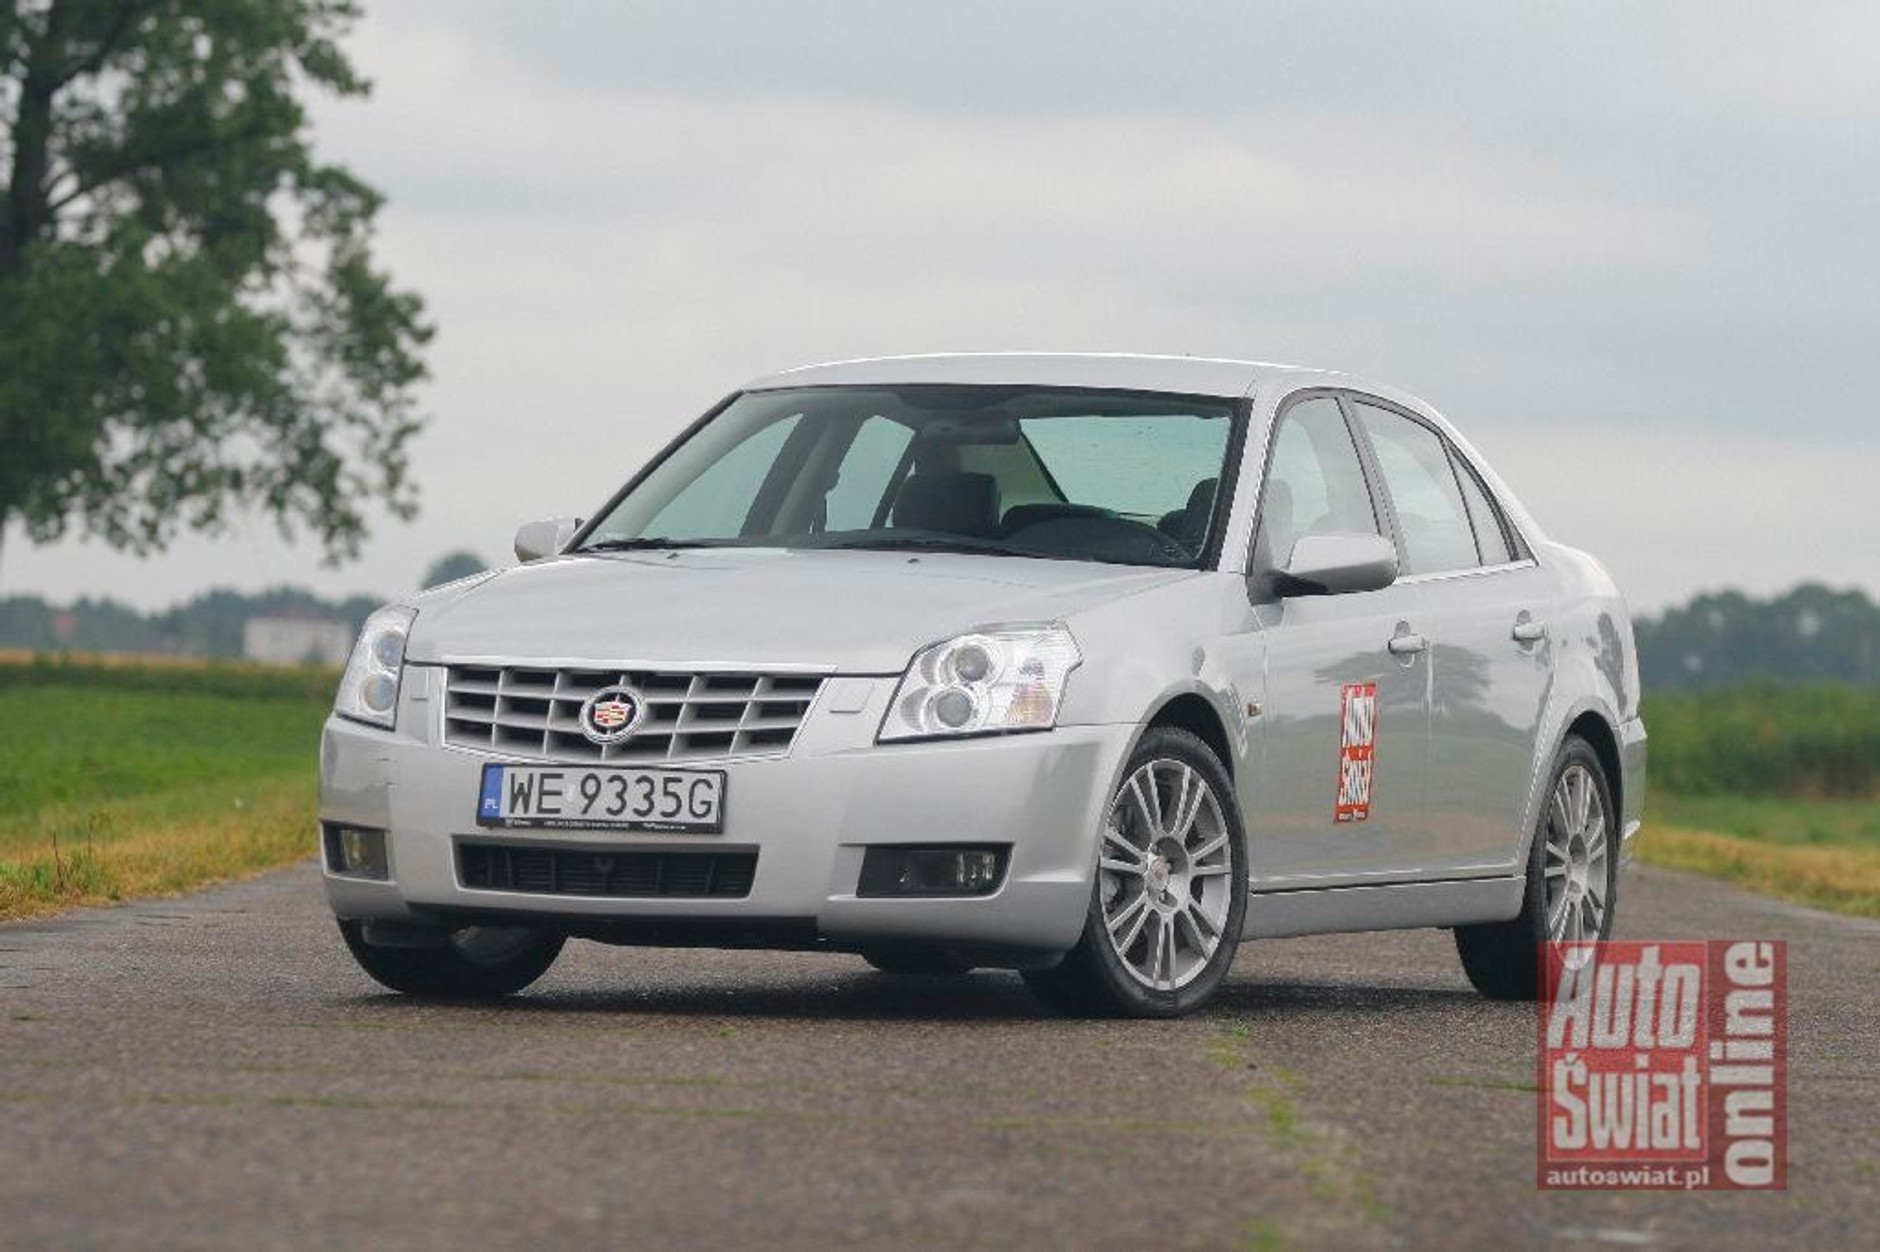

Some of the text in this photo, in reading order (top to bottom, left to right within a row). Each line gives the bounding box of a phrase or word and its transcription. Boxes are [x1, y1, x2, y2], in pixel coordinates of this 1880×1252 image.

[485, 798, 498, 809] PL
[509, 773, 713, 818] WE 9335G
